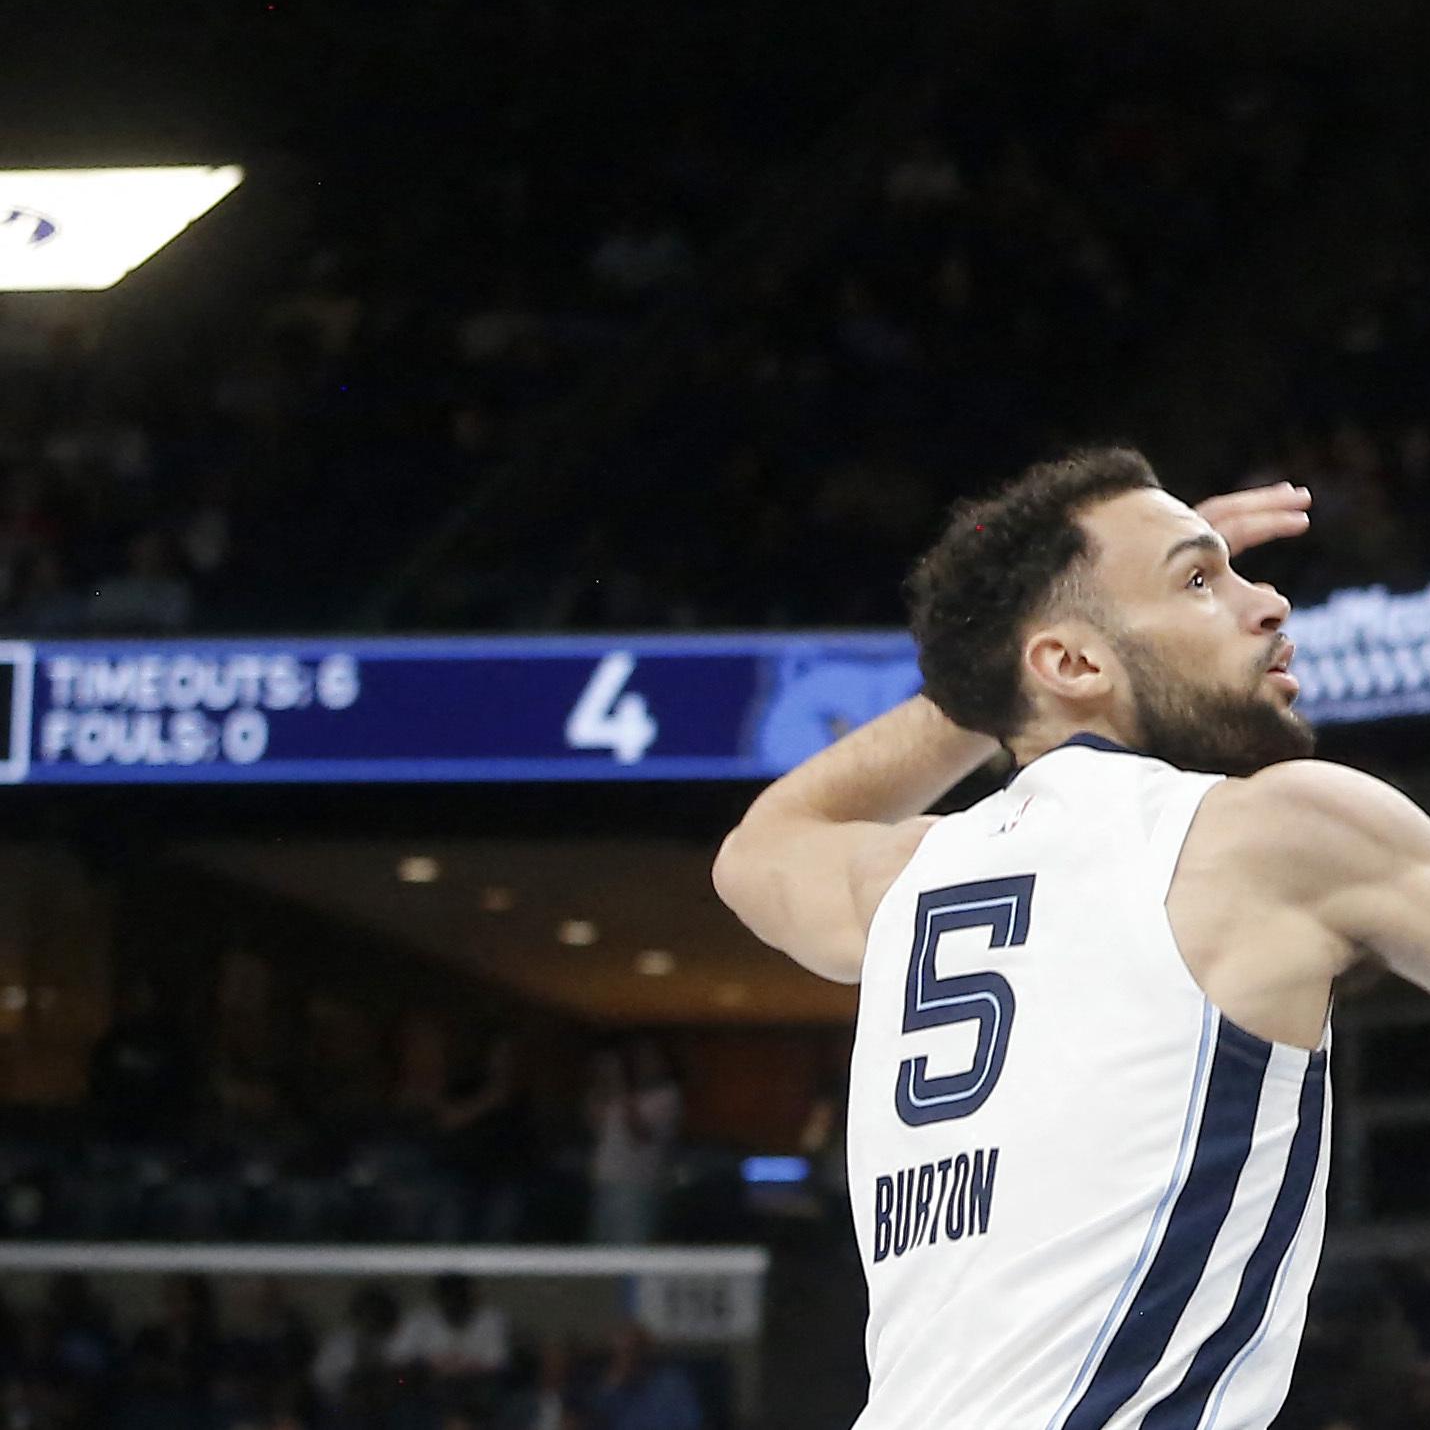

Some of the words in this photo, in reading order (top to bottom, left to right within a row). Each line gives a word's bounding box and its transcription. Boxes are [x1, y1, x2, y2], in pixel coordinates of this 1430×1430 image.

[40, 708, 218, 765] FOULS:
[221, 708, 269, 765] 0
[47, 655, 313, 709] TIMEOUTS:
[316, 652, 359, 710] 6
[564, 649, 657, 766] 4
[895, 873, 1036, 1127] 5
[873, 1148, 1000, 1265] BURTON
